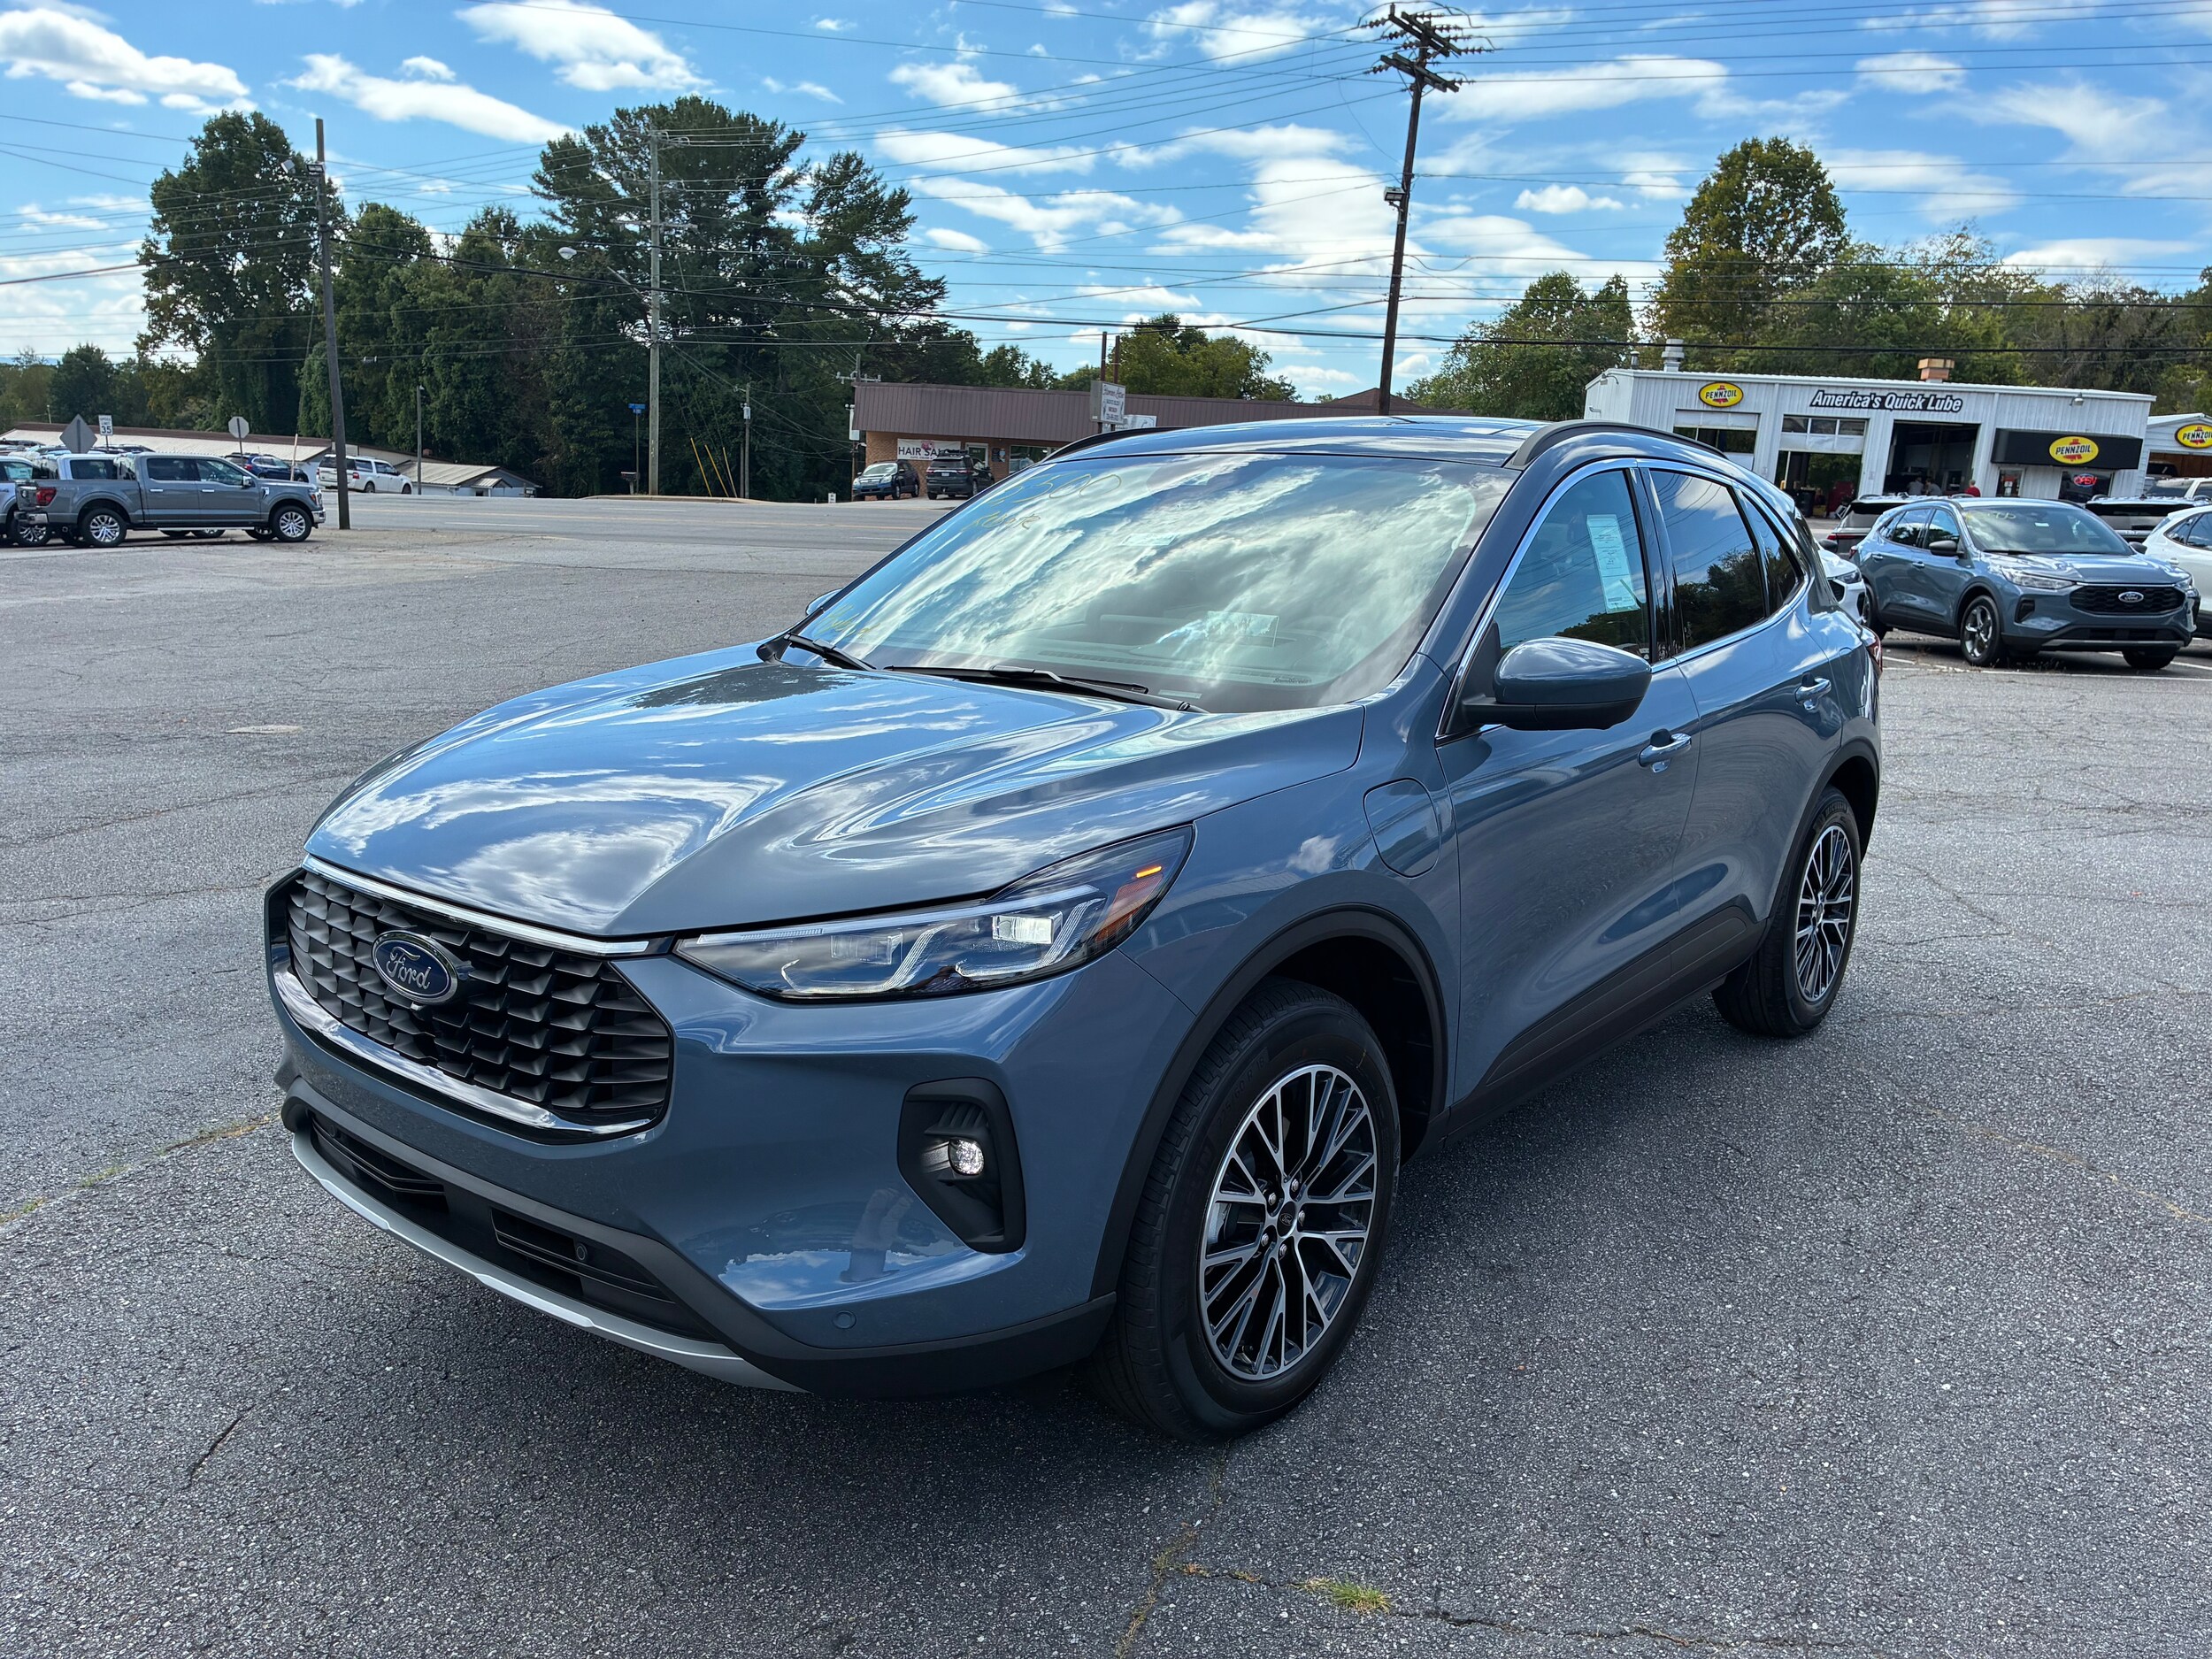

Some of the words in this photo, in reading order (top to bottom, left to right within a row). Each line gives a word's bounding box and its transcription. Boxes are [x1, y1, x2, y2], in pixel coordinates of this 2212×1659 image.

[1705, 389, 1737, 399] PENNZOIL
[1811, 390, 1883, 409] America's
[1884, 392, 1925, 411] Quick
[1926, 395, 1963, 412] Lube
[898, 447, 922, 456] HAIR
[2055, 444, 2091, 455] PENNZOIL
[386, 946, 432, 990] Ford
